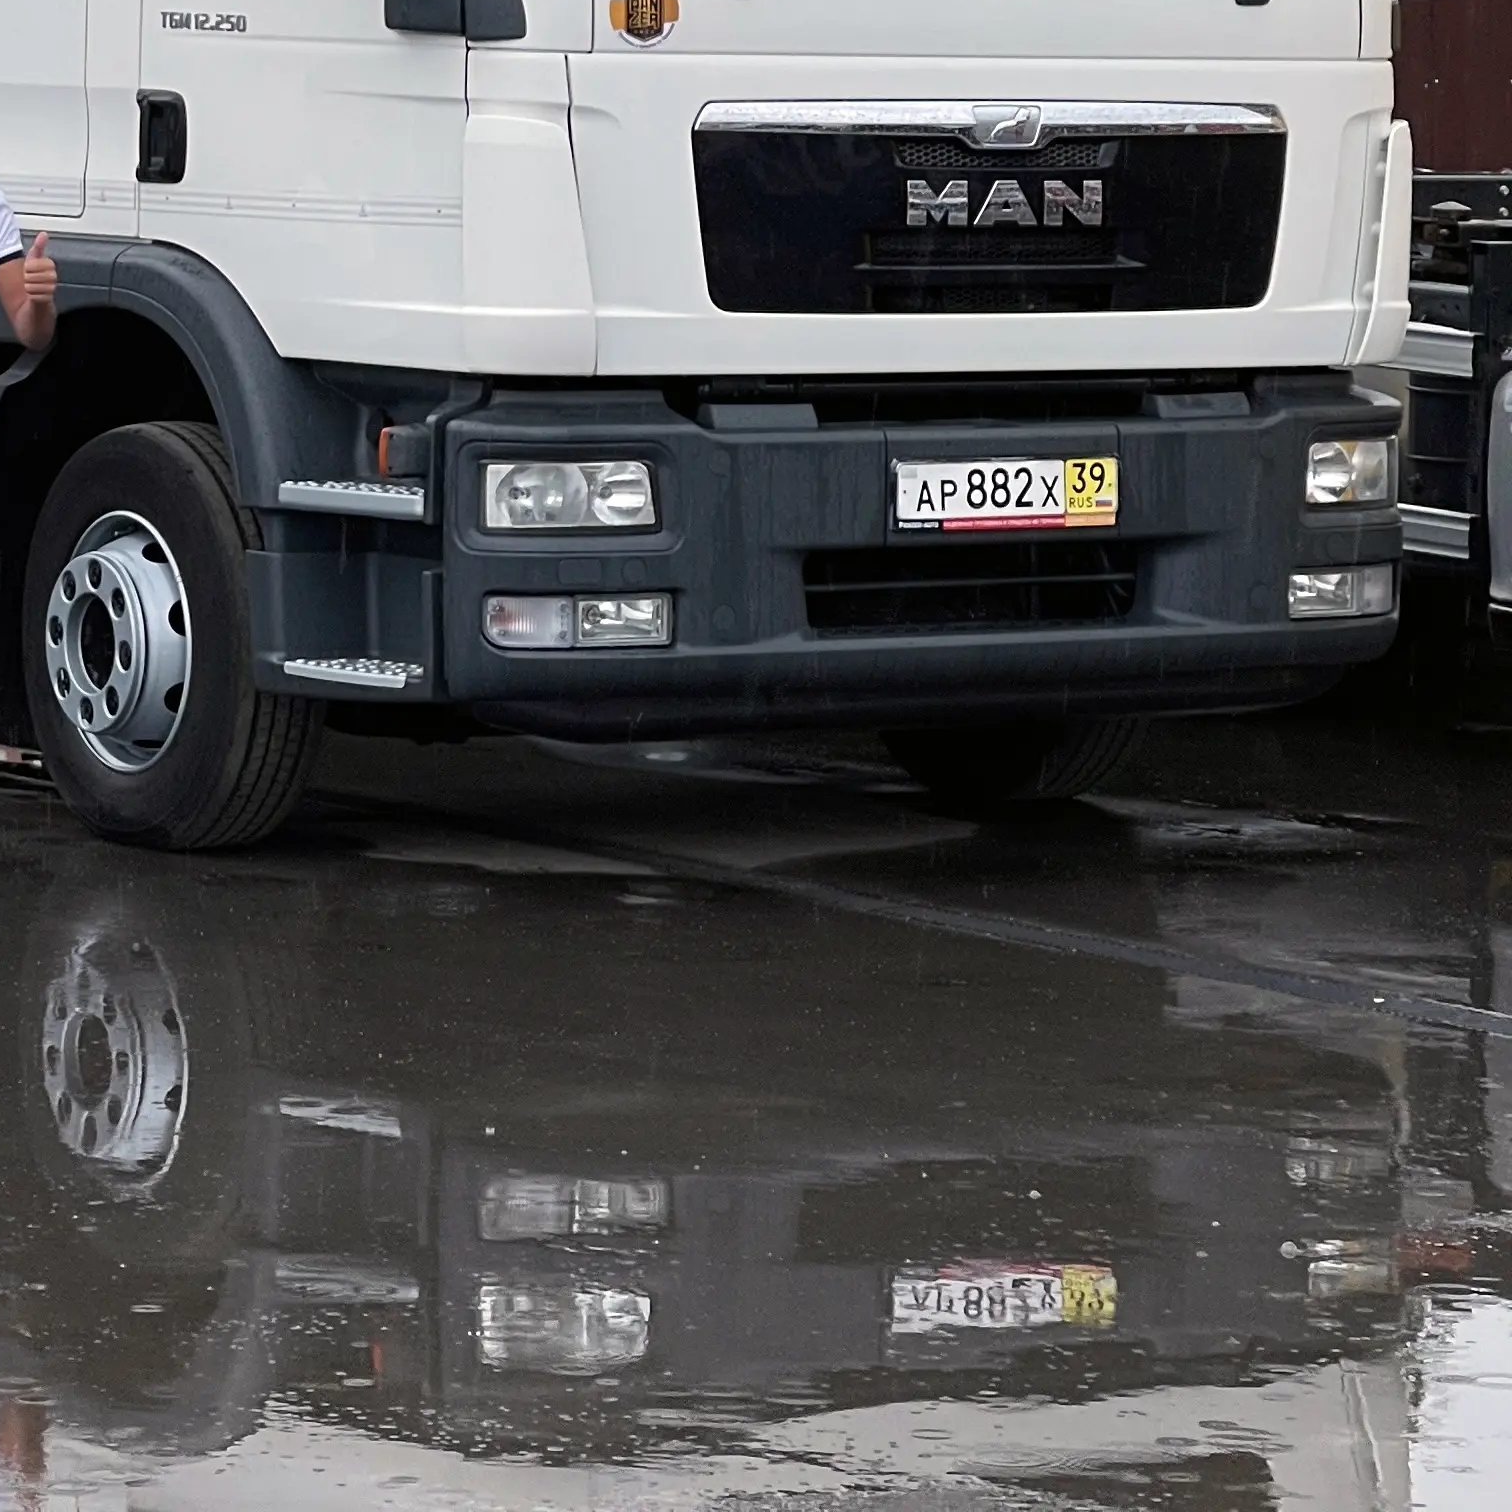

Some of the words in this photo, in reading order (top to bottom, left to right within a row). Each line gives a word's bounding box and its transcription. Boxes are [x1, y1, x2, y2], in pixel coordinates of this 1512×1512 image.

[194, 13, 247, 32] 12.250
[906, 179, 1103, 227] MAN
[1072, 462, 1106, 494] 39
[1069, 496, 1093, 508] RUS
